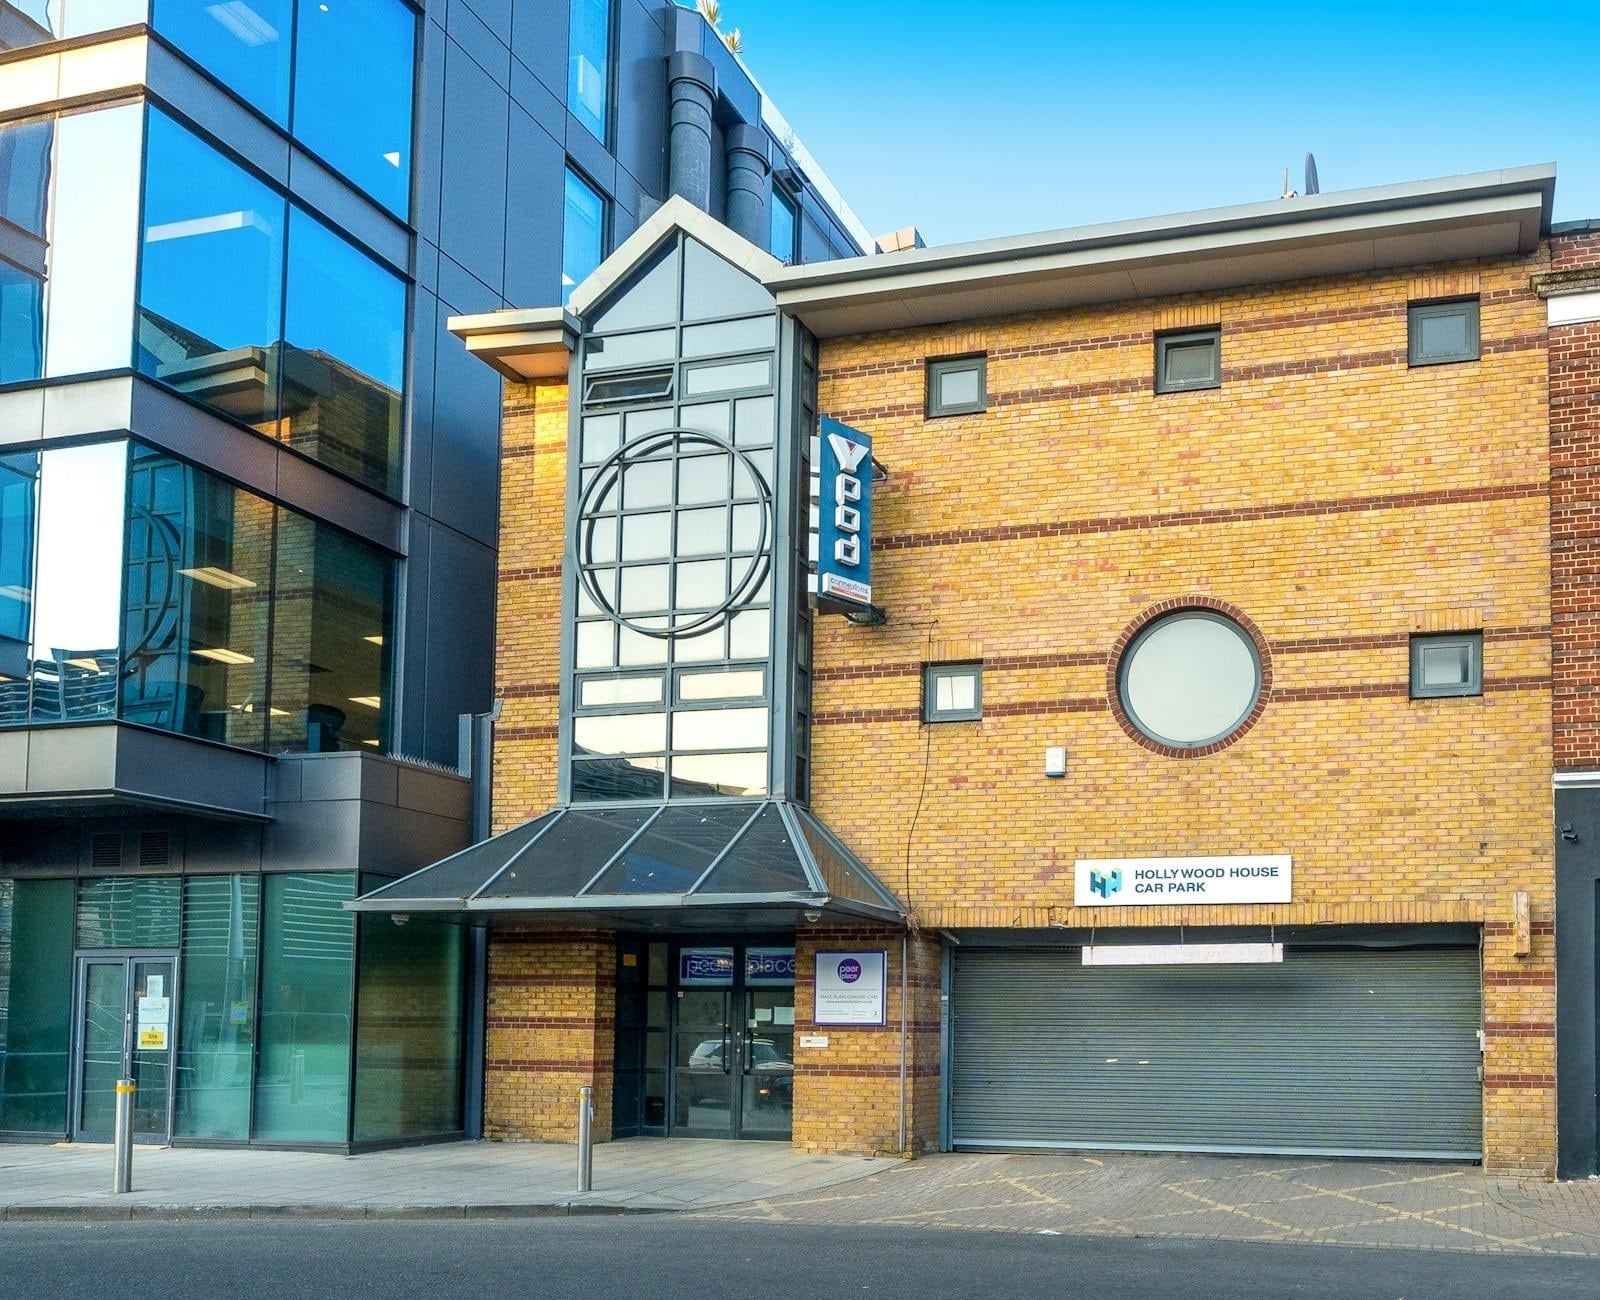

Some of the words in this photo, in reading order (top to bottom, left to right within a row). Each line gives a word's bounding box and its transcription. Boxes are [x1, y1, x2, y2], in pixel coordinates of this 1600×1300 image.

[1135, 868, 1225, 880] HOLLYWOOD
[1229, 867, 1279, 878] HOUSE
[1135, 883, 1164, 894] CAR
[1168, 882, 1206, 893] PARK
[840, 965, 859, 981] peer
[841, 973, 857, 981] place
